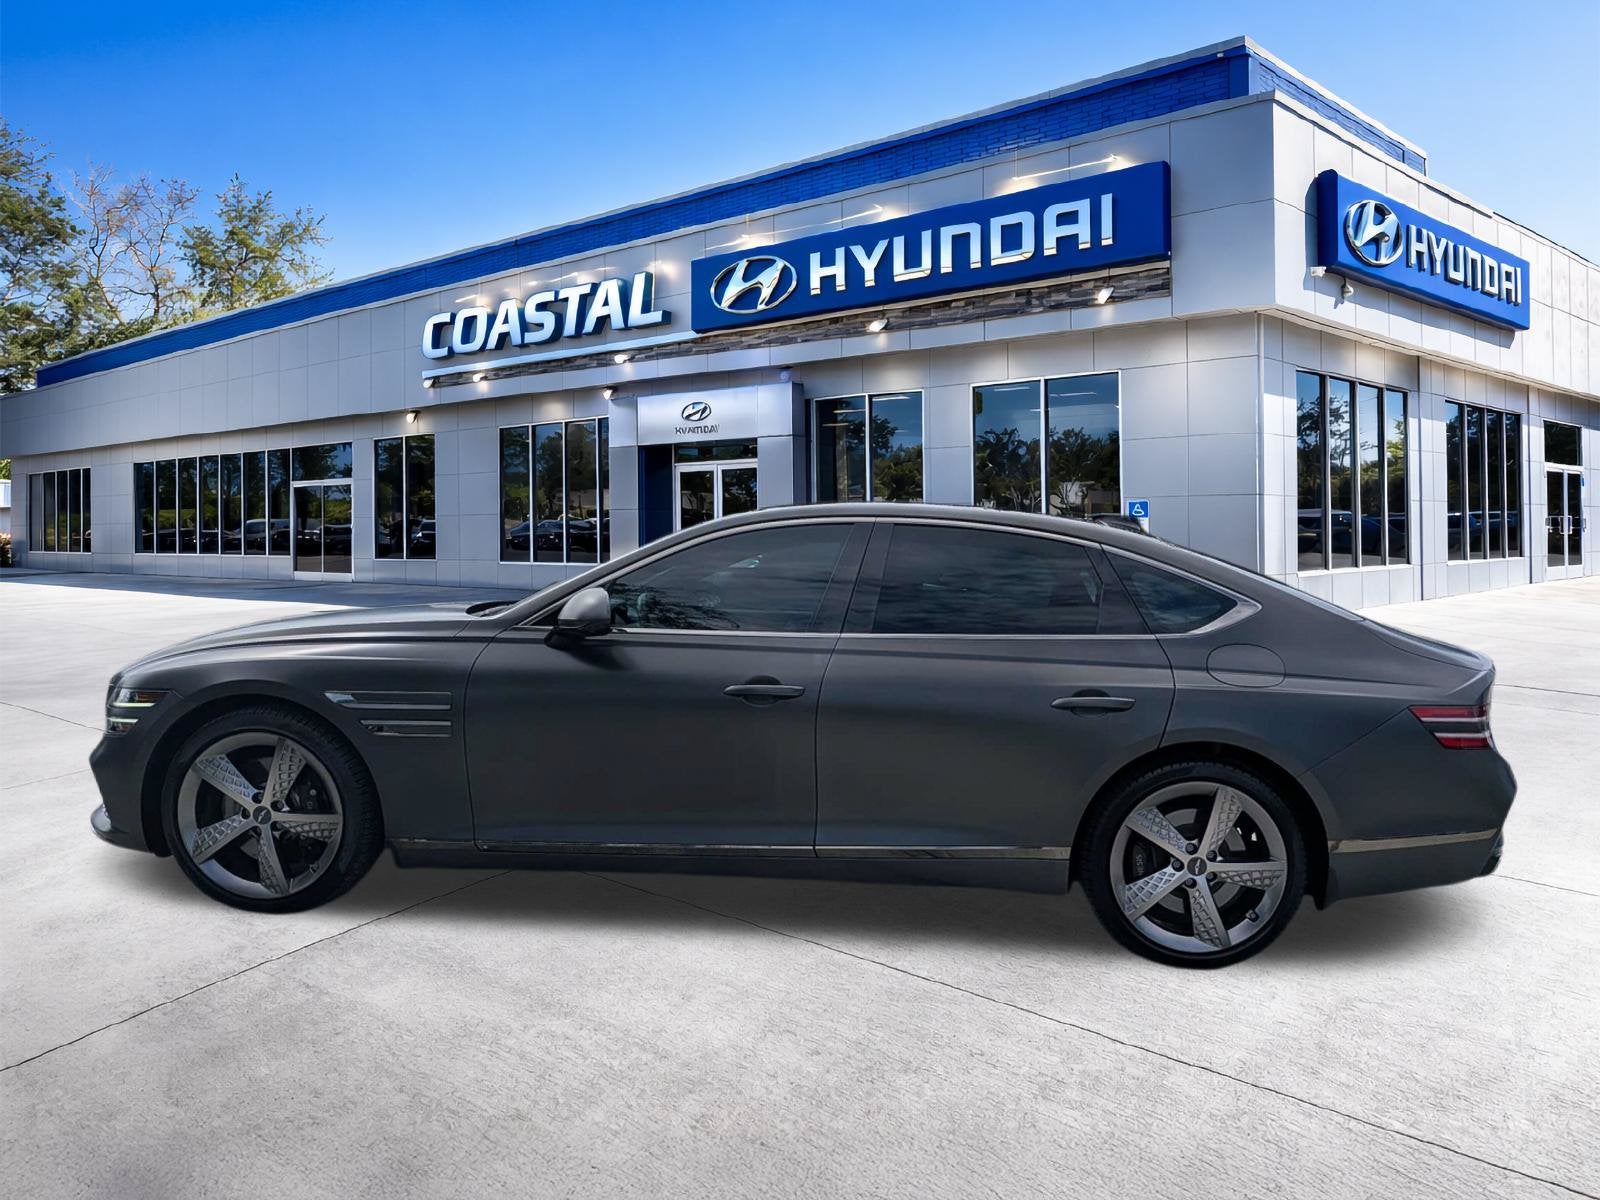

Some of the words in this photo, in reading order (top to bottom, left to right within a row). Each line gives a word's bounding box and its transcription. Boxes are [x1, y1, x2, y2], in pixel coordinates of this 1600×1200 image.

[809, 192, 1114, 296] HYUNDAI
[1406, 223, 1522, 307] HYUNDAI
[422, 271, 671, 359] COASTAL
